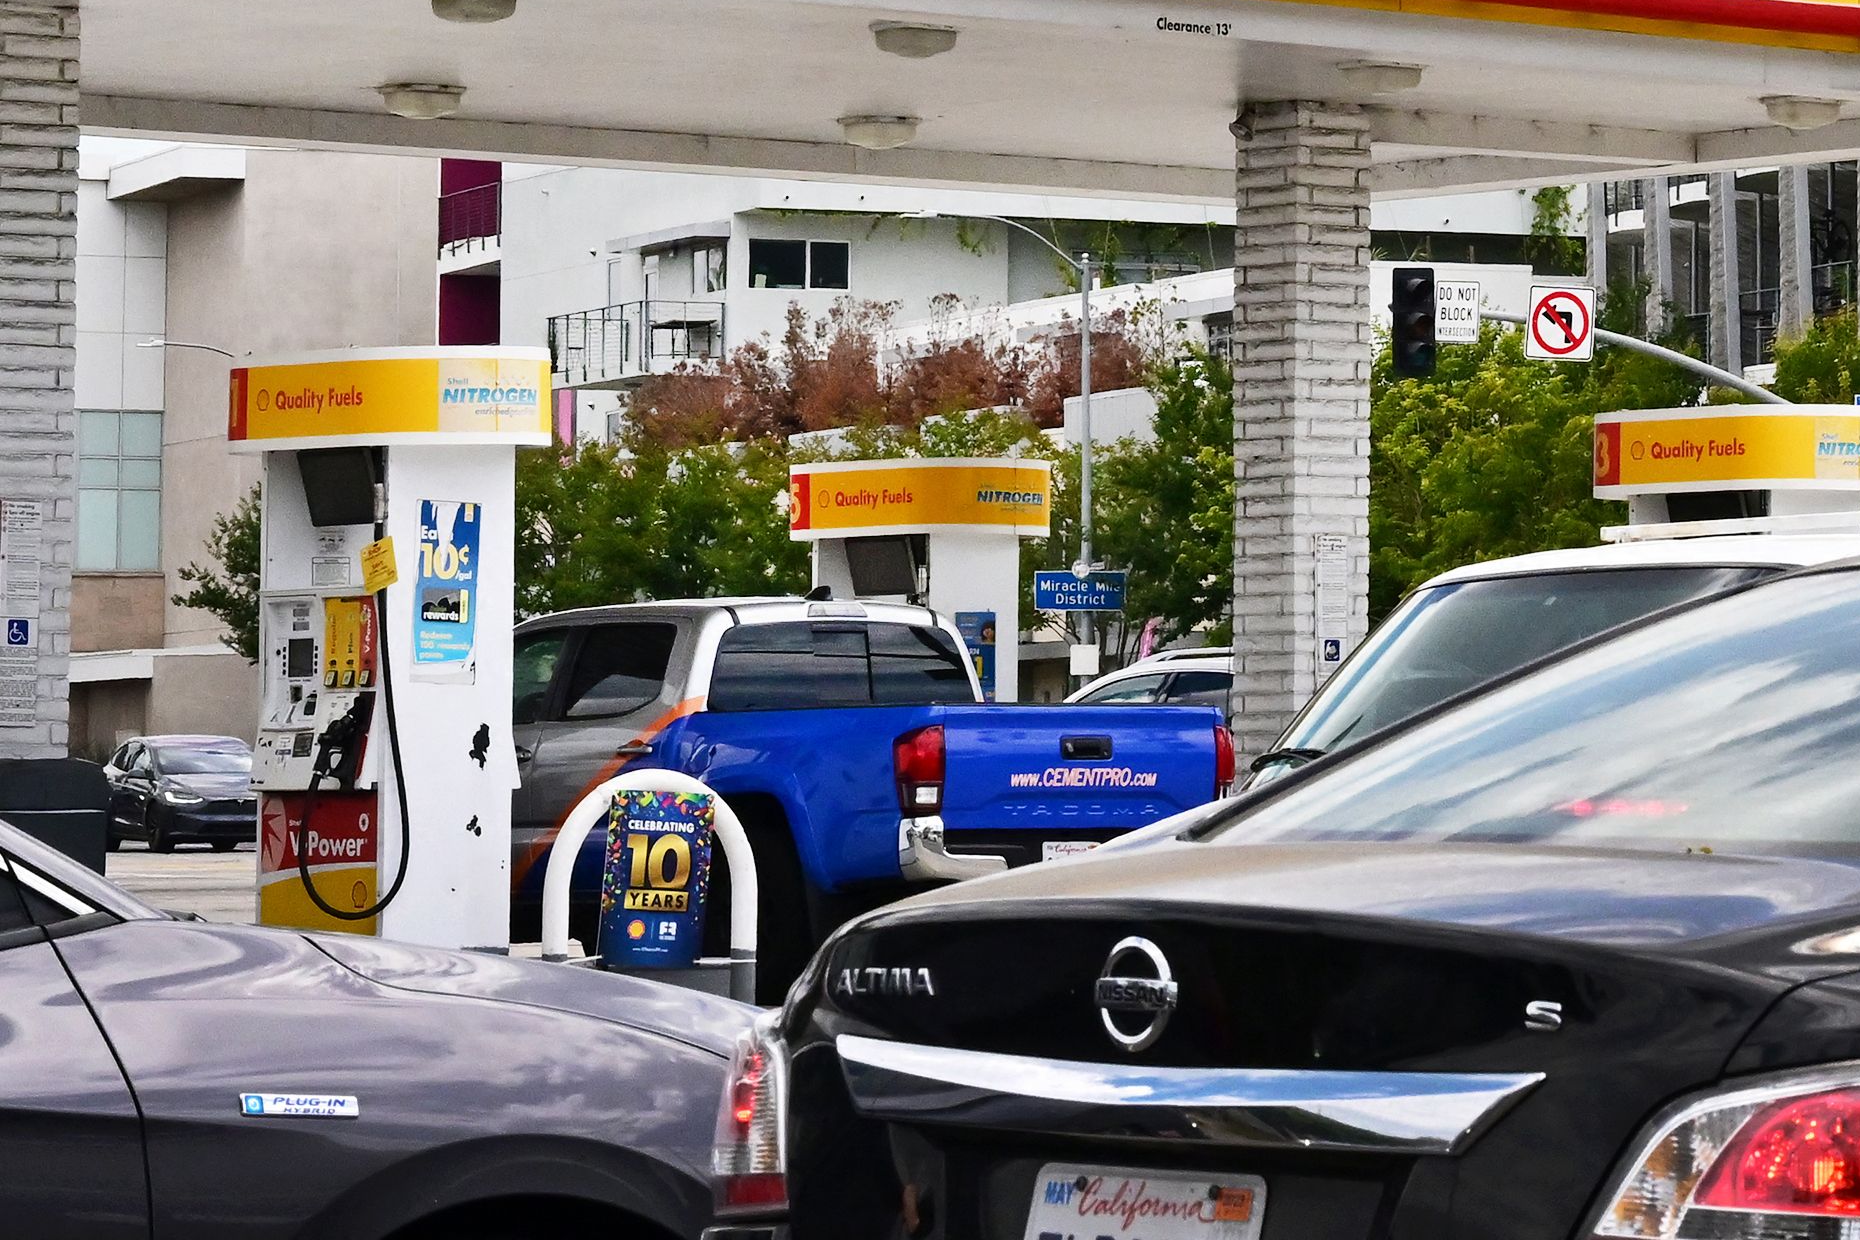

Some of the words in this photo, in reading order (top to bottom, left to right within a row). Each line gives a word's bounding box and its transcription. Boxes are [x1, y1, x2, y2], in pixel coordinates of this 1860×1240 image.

[1156, 17, 1211, 34] Clearance
[1216, 23, 1232, 35] 13'
[1439, 287, 1453, 301] DO
[1458, 287, 1477, 301] NOT
[1440, 307, 1473, 321] BLOCK
[1436, 327, 1476, 337] INTERSECTION
[275, 388, 324, 414] Quality
[328, 385, 364, 407] Fuels
[442, 387, 537, 405] NITROGEN
[1651, 441, 1702, 463] Quality
[1708, 438, 1745, 457] Fuels
[835, 491, 878, 510] Quality
[882, 487, 913, 504] Fuels
[977, 490, 1044, 505] NITROGEN
[1040, 580, 1088, 592] Miracle
[1055, 593, 1105, 605] District
[423, 610, 459, 621] rewards
[628, 819, 695, 834] CELEBRATING
[627, 833, 691, 890] 10
[630, 892, 685, 910] YEARS
[836, 967, 935, 996] ALTIMA
[1097, 981, 1166, 1008] NISSAN
[1524, 1000, 1562, 1031] S
[273, 1097, 346, 1107] PLUG-IN
[283, 1107, 336, 1115] HYBRID
[1044, 1181, 1074, 1205] MAY
[1078, 1176, 1216, 1232] California
